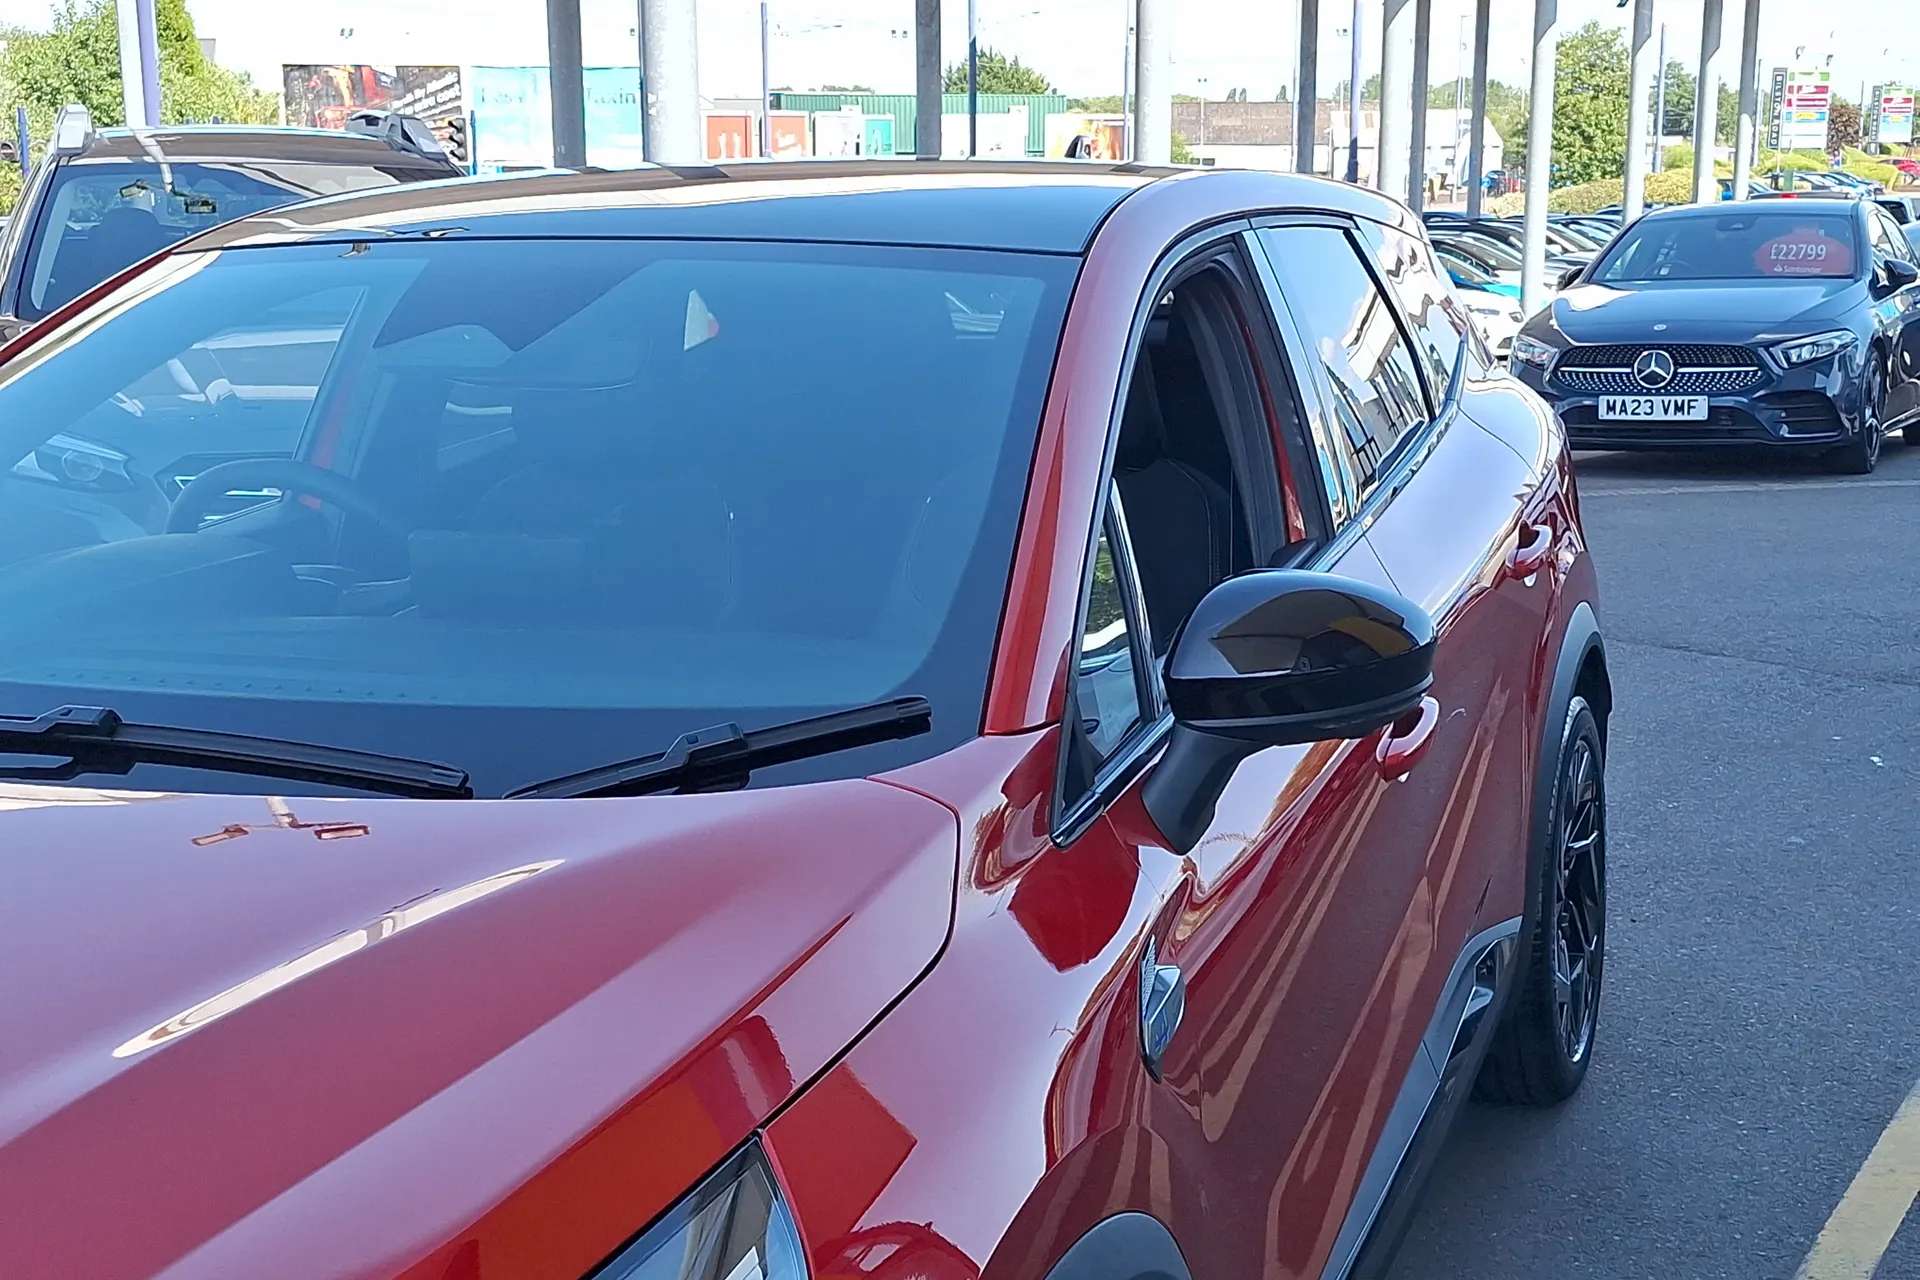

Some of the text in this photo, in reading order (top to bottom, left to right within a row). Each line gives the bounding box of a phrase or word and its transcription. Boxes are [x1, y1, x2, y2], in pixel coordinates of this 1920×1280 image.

[1770, 243, 1826, 260] £22799
[1606, 399, 1699, 416] MA23 VMF
